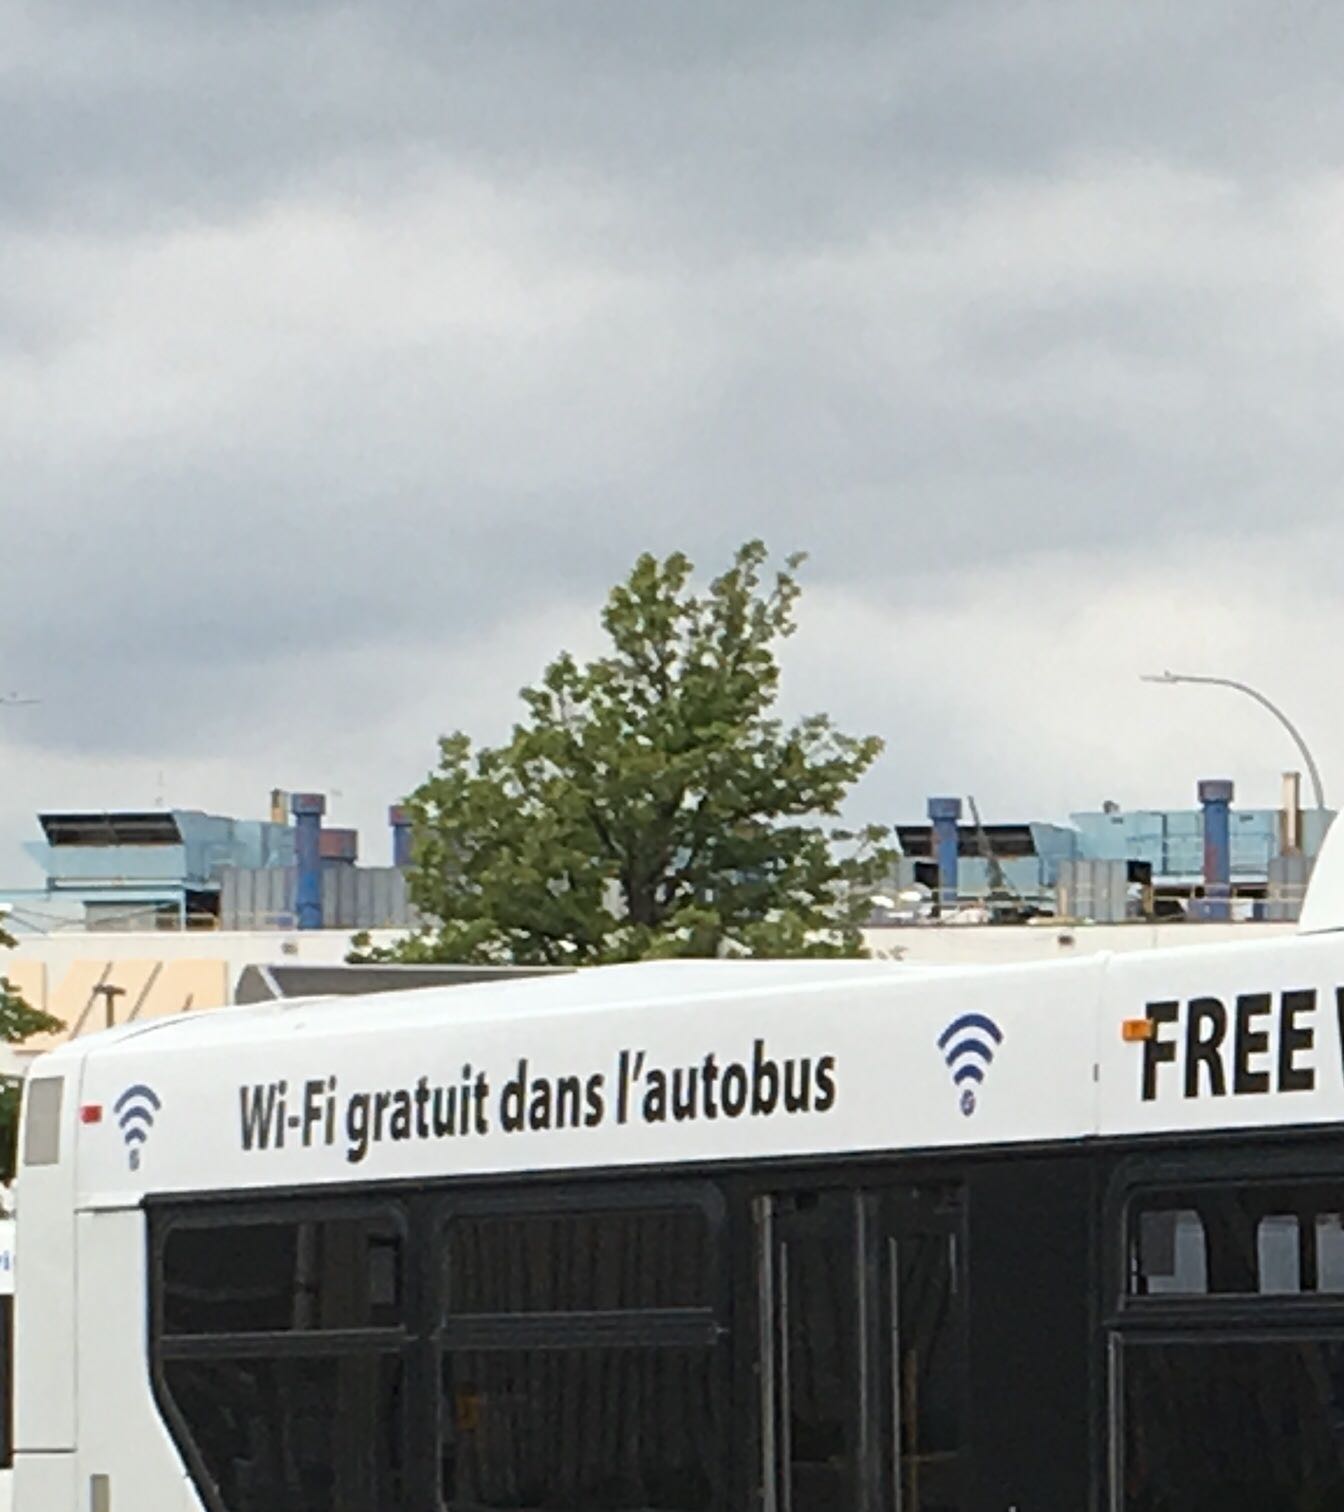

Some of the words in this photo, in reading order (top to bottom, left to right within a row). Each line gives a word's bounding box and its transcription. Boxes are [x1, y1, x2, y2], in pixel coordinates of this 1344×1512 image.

[1141, 989, 1317, 1102] FREE
[239, 1075, 337, 1151] Wi-Fi
[346, 1064, 489, 1163] gratuit
[500, 1058, 604, 1134] dans
